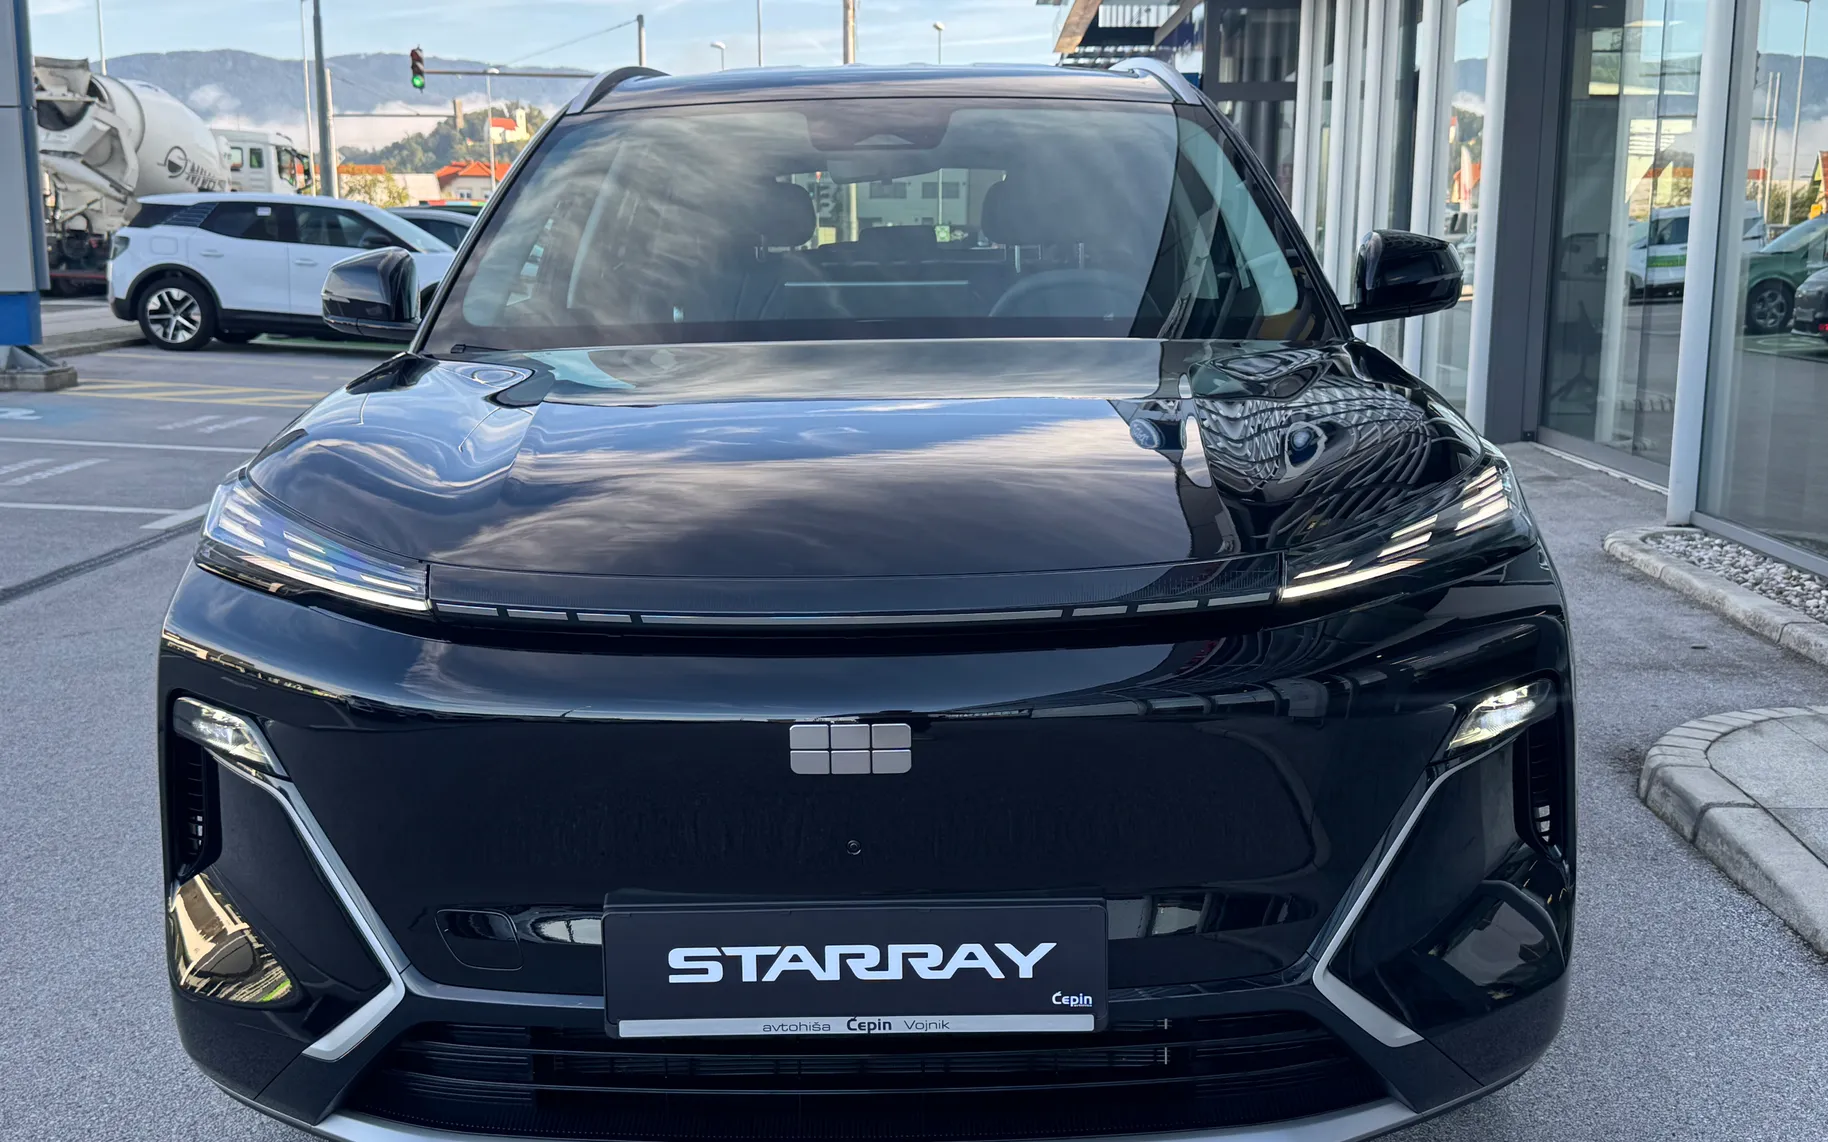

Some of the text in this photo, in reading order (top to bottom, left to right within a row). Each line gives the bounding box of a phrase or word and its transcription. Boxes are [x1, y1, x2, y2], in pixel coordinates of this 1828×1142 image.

[668, 942, 1058, 984] STARRAY
[762, 1021, 831, 1032] avtohiša
[903, 1019, 950, 1031] Vojnik
